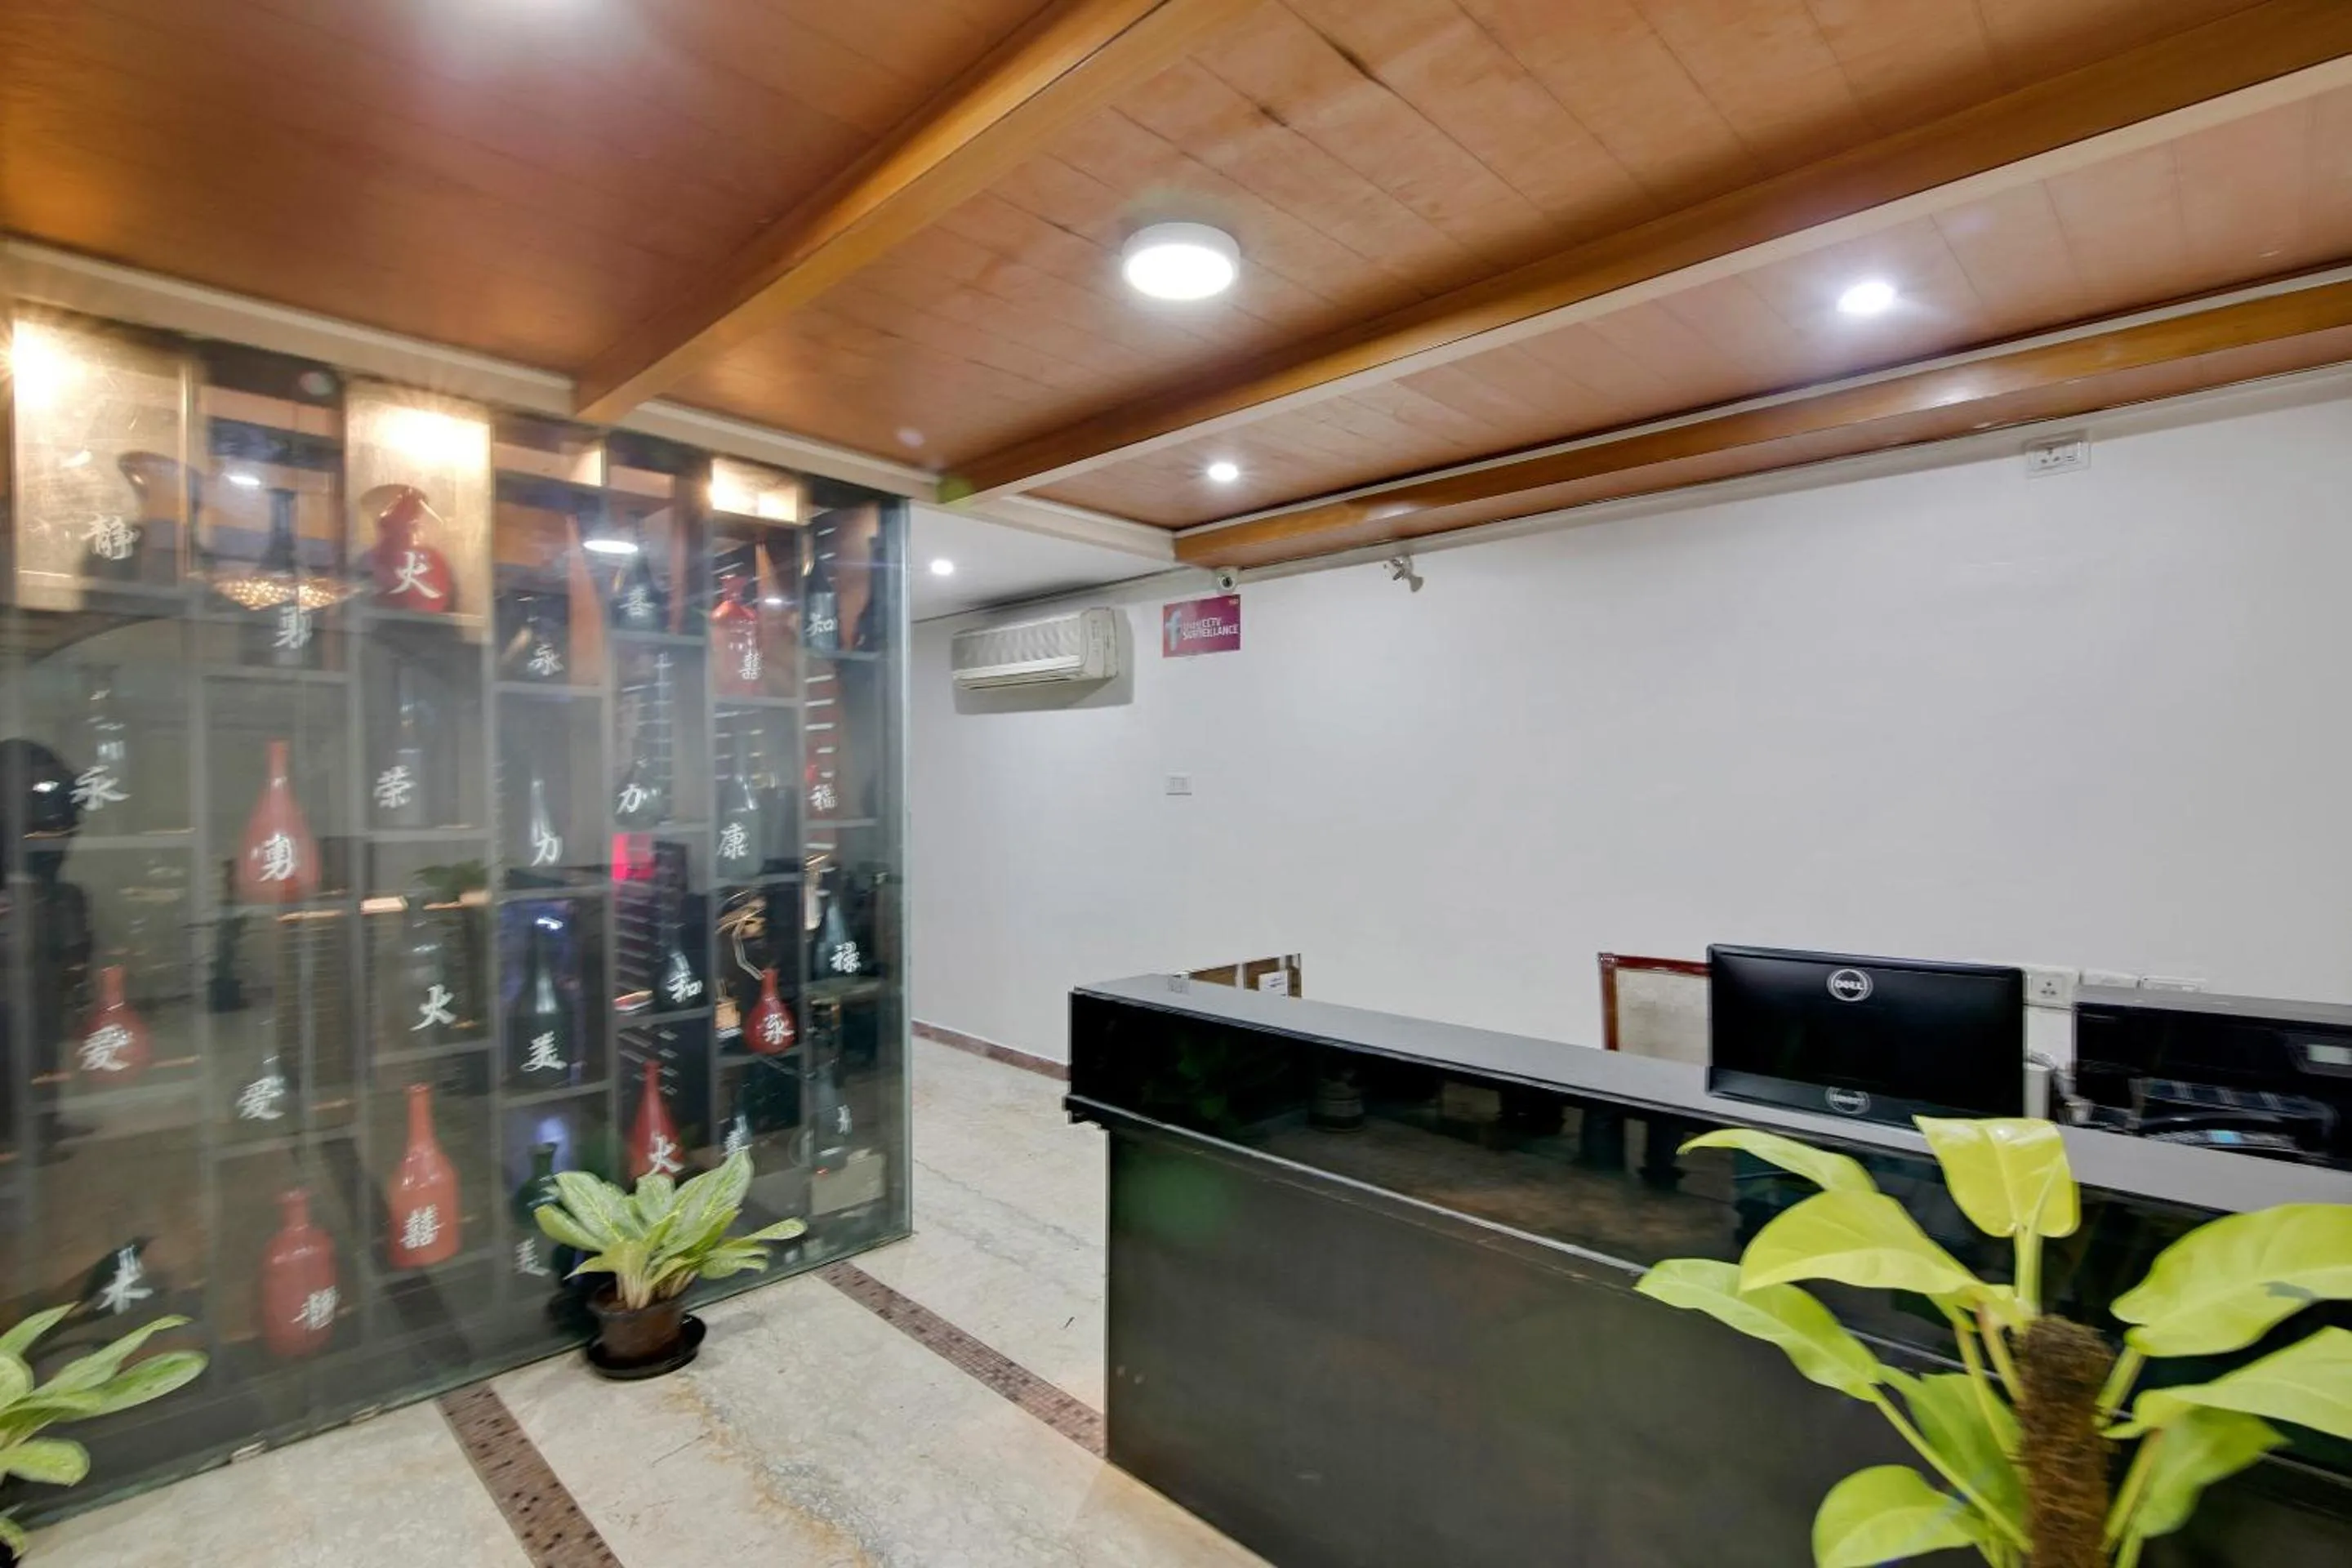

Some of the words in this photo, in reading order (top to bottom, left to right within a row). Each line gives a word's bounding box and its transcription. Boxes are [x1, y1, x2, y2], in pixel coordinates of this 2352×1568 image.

[70, 764, 131, 811] 永
[531, 831, 564, 867] 力
[717, 822, 750, 860] 康
[1834, 979, 1864, 991] DELL
